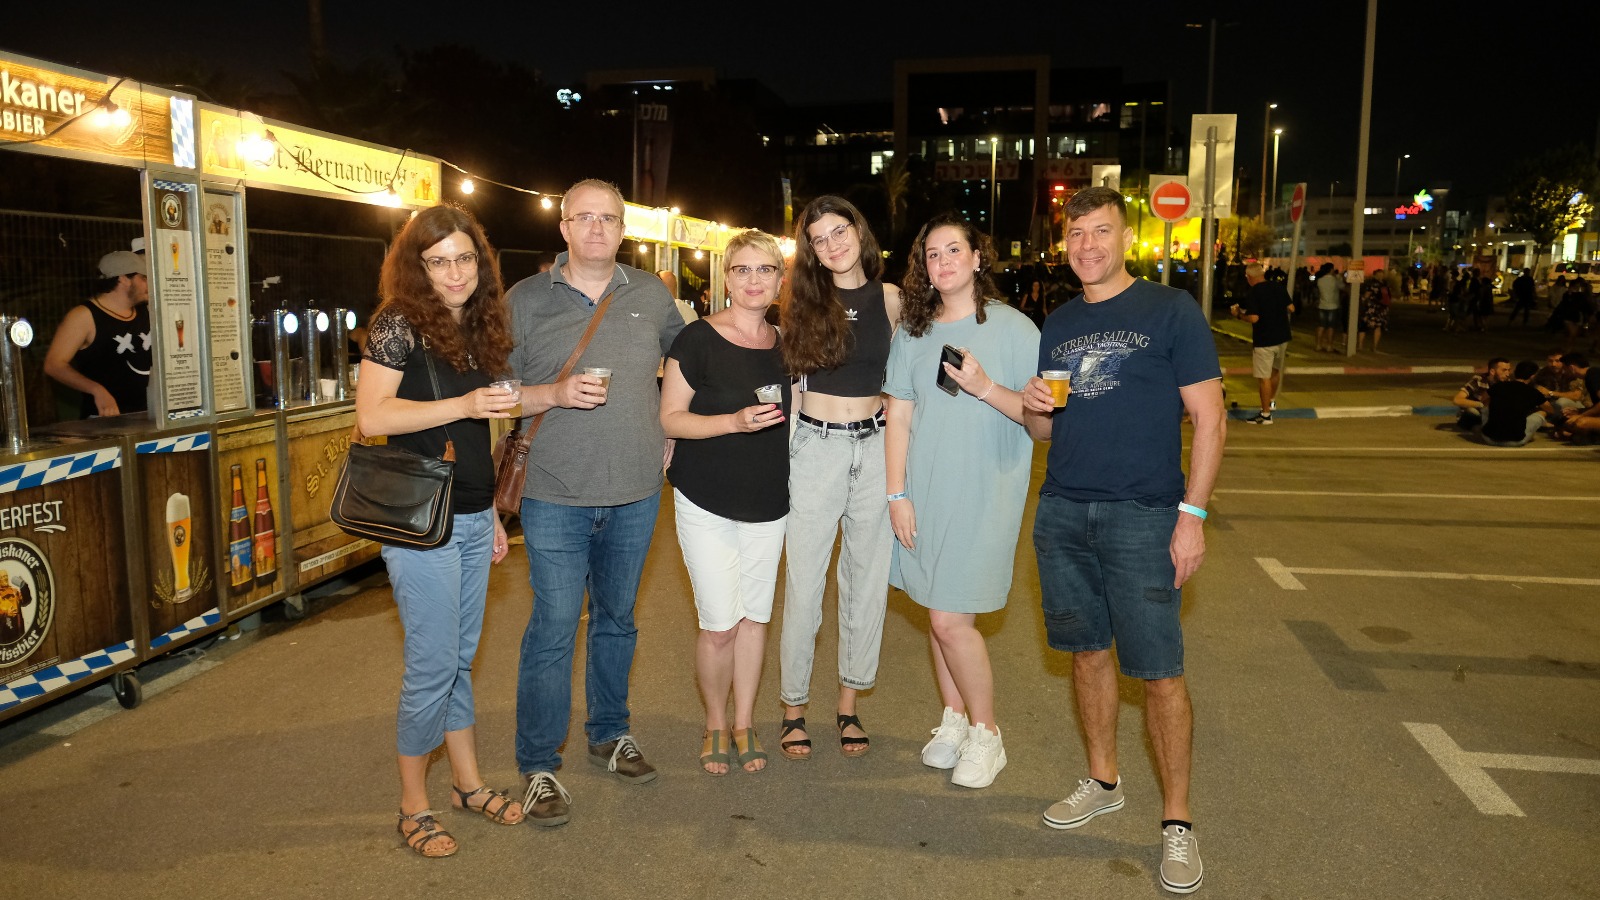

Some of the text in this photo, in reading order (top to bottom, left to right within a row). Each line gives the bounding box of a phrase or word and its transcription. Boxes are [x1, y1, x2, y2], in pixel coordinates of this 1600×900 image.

[0, 70, 86, 116] kaner
[0, 108, 47, 137] BIER
[293, 145, 393, 188] Bernardus
[1051, 330, 1151, 359] EXTREME SAILING
[1062, 341, 1128, 357] CLASSICAL YACHTING
[306, 462, 329, 498] St.
